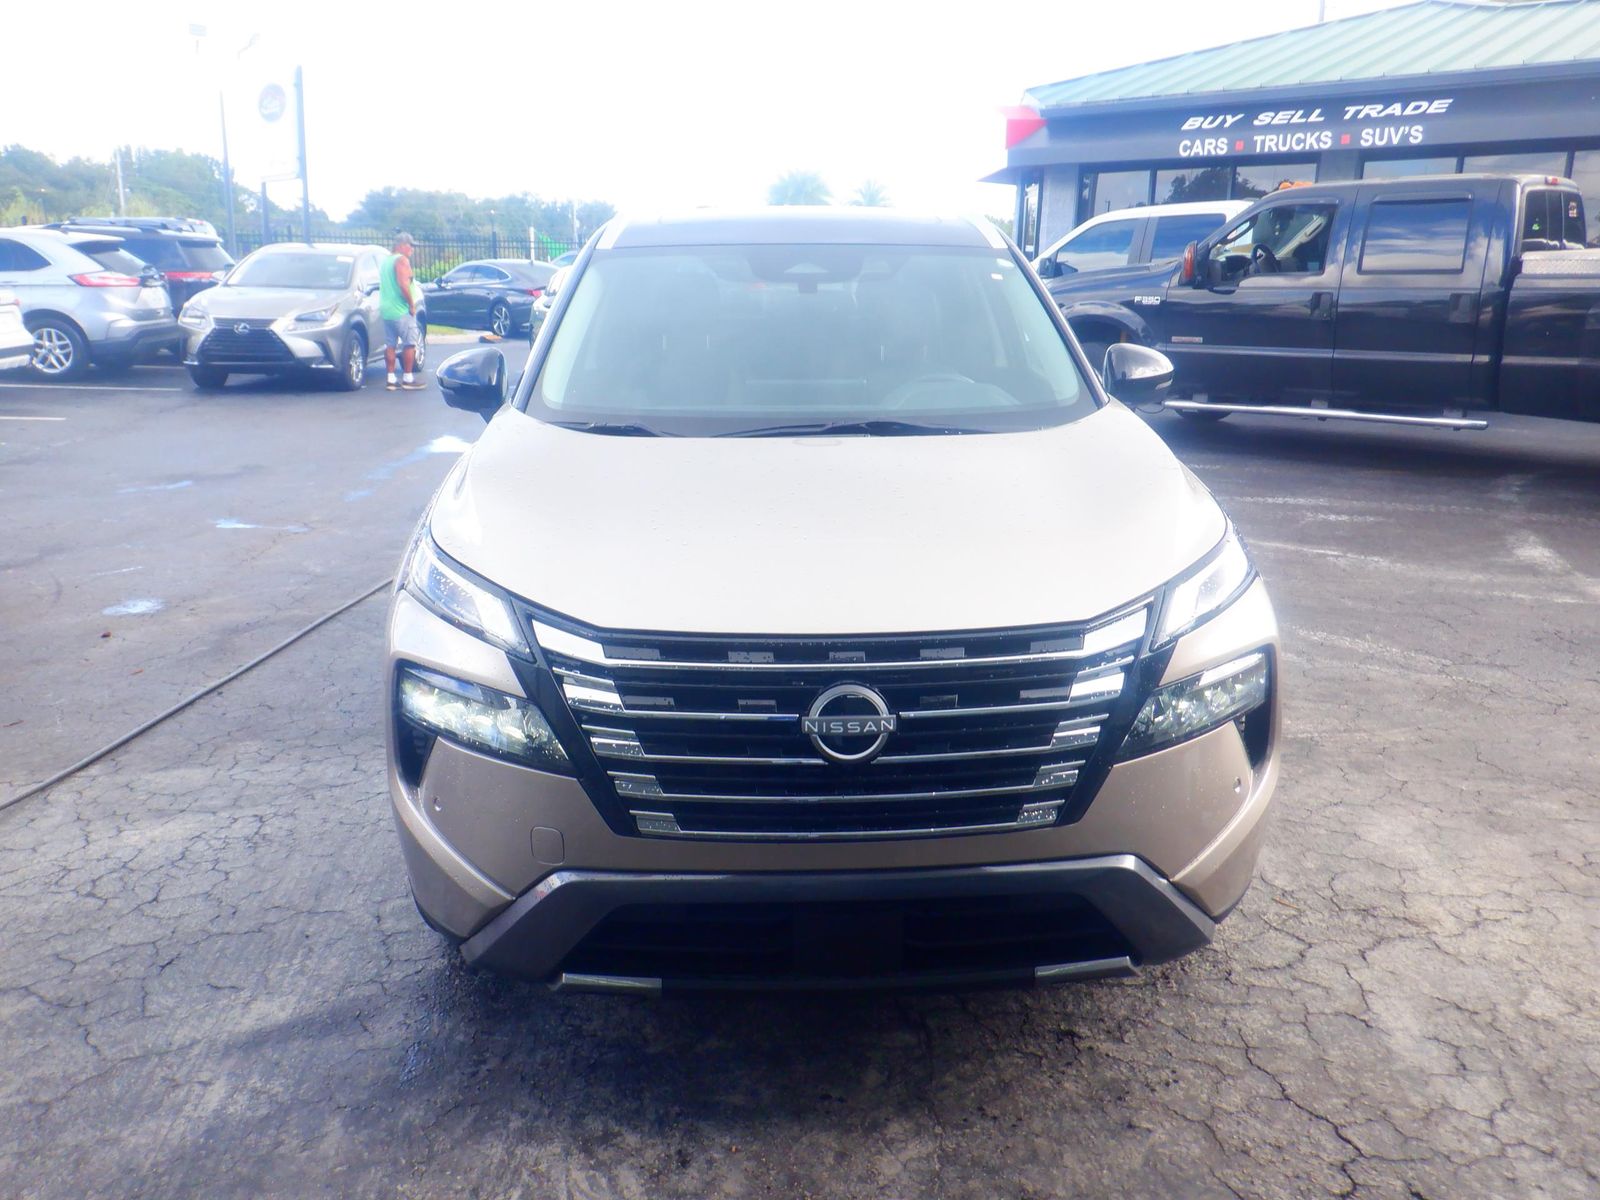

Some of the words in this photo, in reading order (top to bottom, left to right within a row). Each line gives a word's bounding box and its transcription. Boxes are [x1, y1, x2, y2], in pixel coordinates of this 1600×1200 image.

[1180, 113, 1245, 131] BUY
[1252, 108, 1325, 126] SELL
[1343, 98, 1454, 120] TRADE
[1178, 136, 1229, 158] CARS
[1253, 130, 1333, 153] TRUCKS
[1359, 124, 1424, 147] SUV'S
[804, 719, 894, 734] NISSAN
